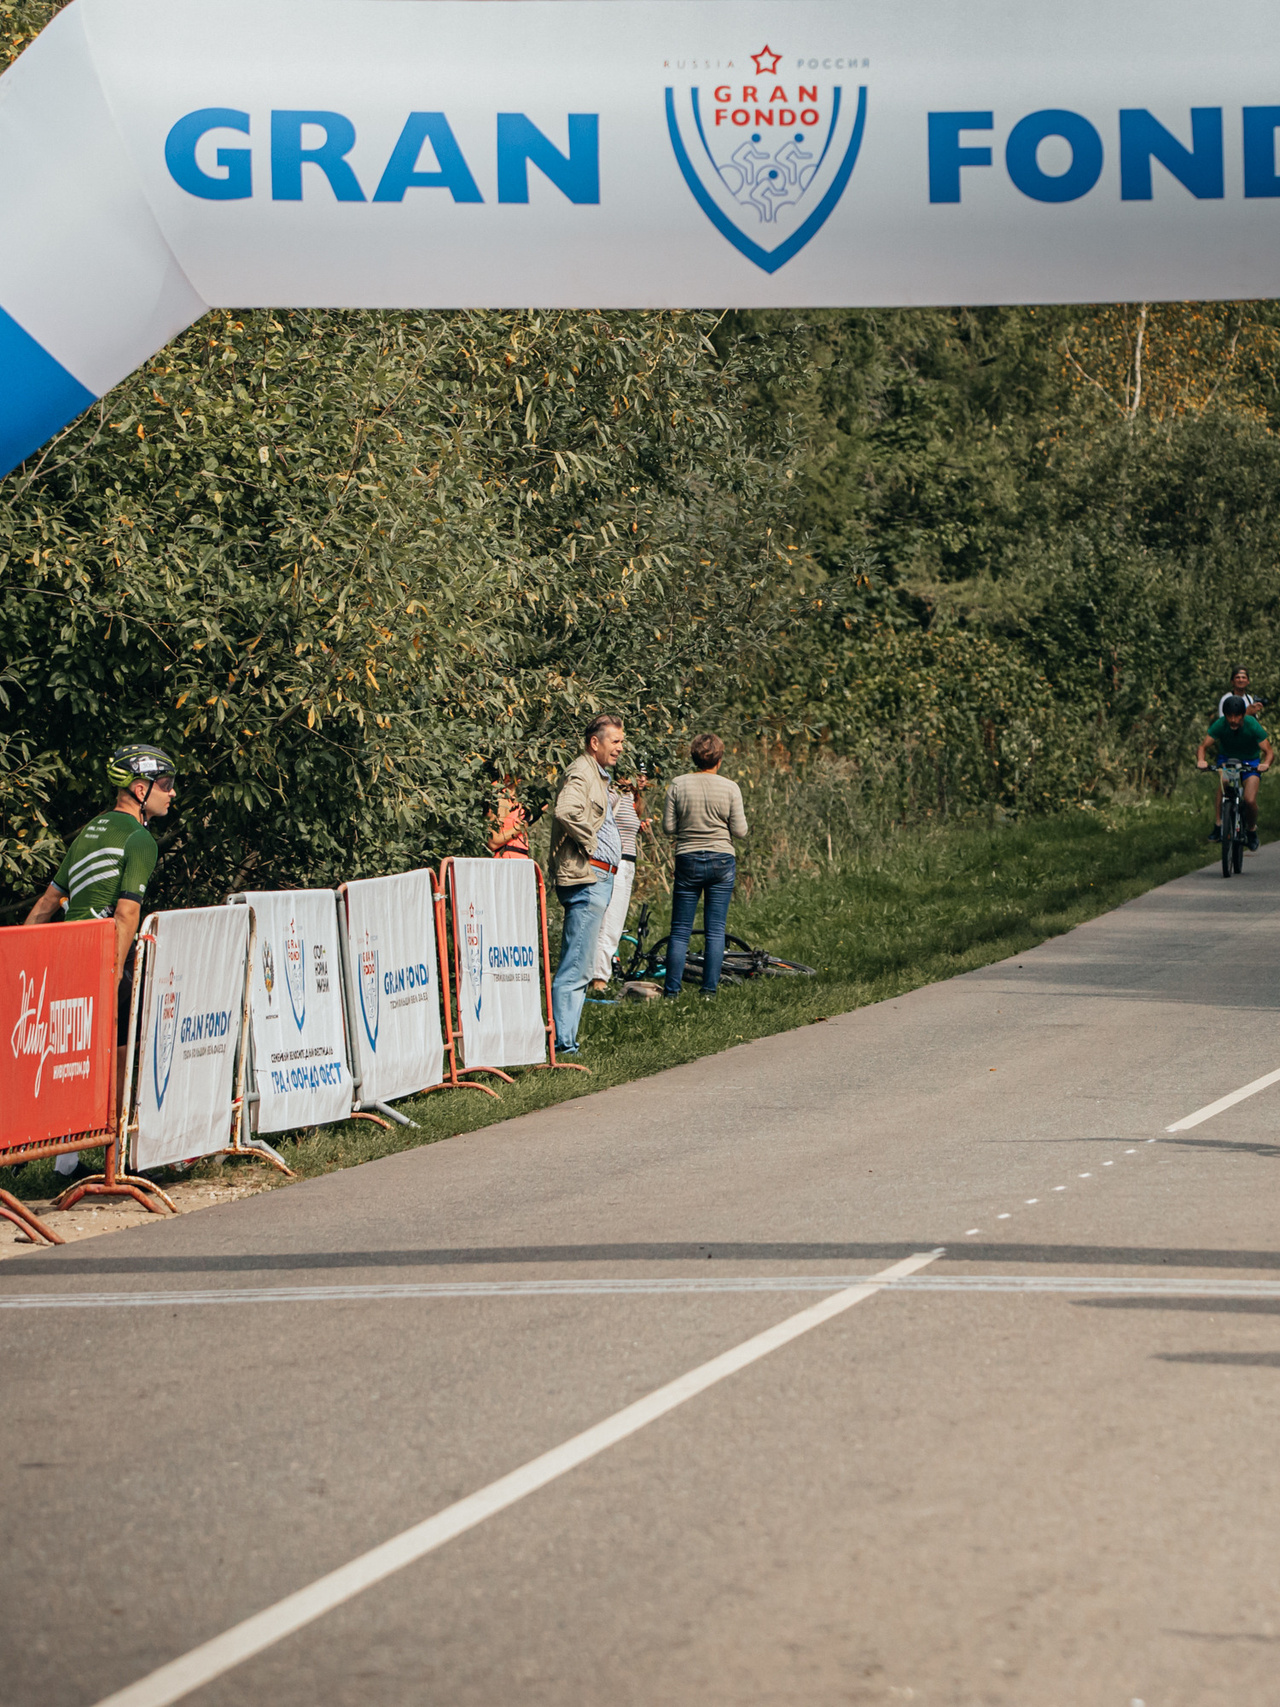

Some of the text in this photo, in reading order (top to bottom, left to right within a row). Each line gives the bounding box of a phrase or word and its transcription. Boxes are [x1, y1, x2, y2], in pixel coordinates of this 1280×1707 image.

[664, 60, 735, 70] RUSSIA
[797, 57, 870, 70] РОССИЯ
[714, 85, 818, 103] GRAN
[715, 108, 820, 127] FONDO
[164, 107, 601, 205] GRAN
[510, 945, 534, 968] FODO
[319, 1061, 342, 1086] ФЕСТ
